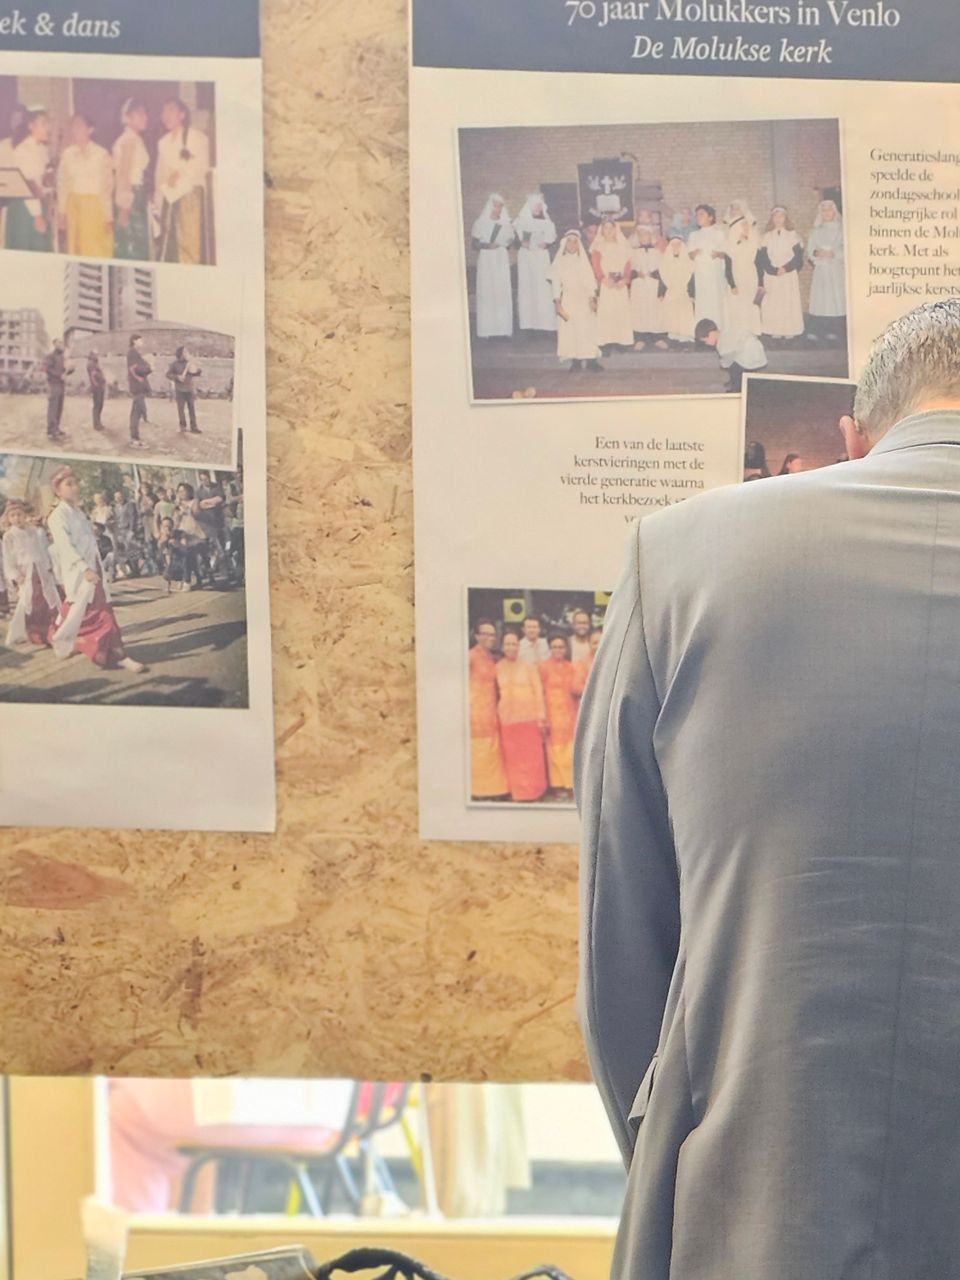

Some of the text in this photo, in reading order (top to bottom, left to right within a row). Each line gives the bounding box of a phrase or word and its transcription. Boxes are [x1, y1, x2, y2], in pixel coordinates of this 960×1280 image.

[566, 0, 901, 27] 70 jaar Molukkers in Venlo
[35, 12, 55, 36] &
[62, 12, 121, 38] dans
[632, 35, 833, 64] De Molukse kerk
[871, 169, 934, 184] speelde de
[870, 188, 959, 202] zondagsschool
[870, 206, 958, 222] belangrijke rol
[870, 225, 911, 237] binnen
[915, 226, 930, 238] de
[869, 244, 949, 257] kerk. Met als
[869, 263, 940, 279] hoogtepunt
[867, 282, 922, 297] jaarlijkse
[595, 436, 704, 451] Een van de laatste
[574, 455, 704, 471] kerstvieringen met de
[560, 474, 704, 489] vierde generatie waarna
[580, 492, 600, 504] het
[602, 493, 671, 506] kerkbezoek
